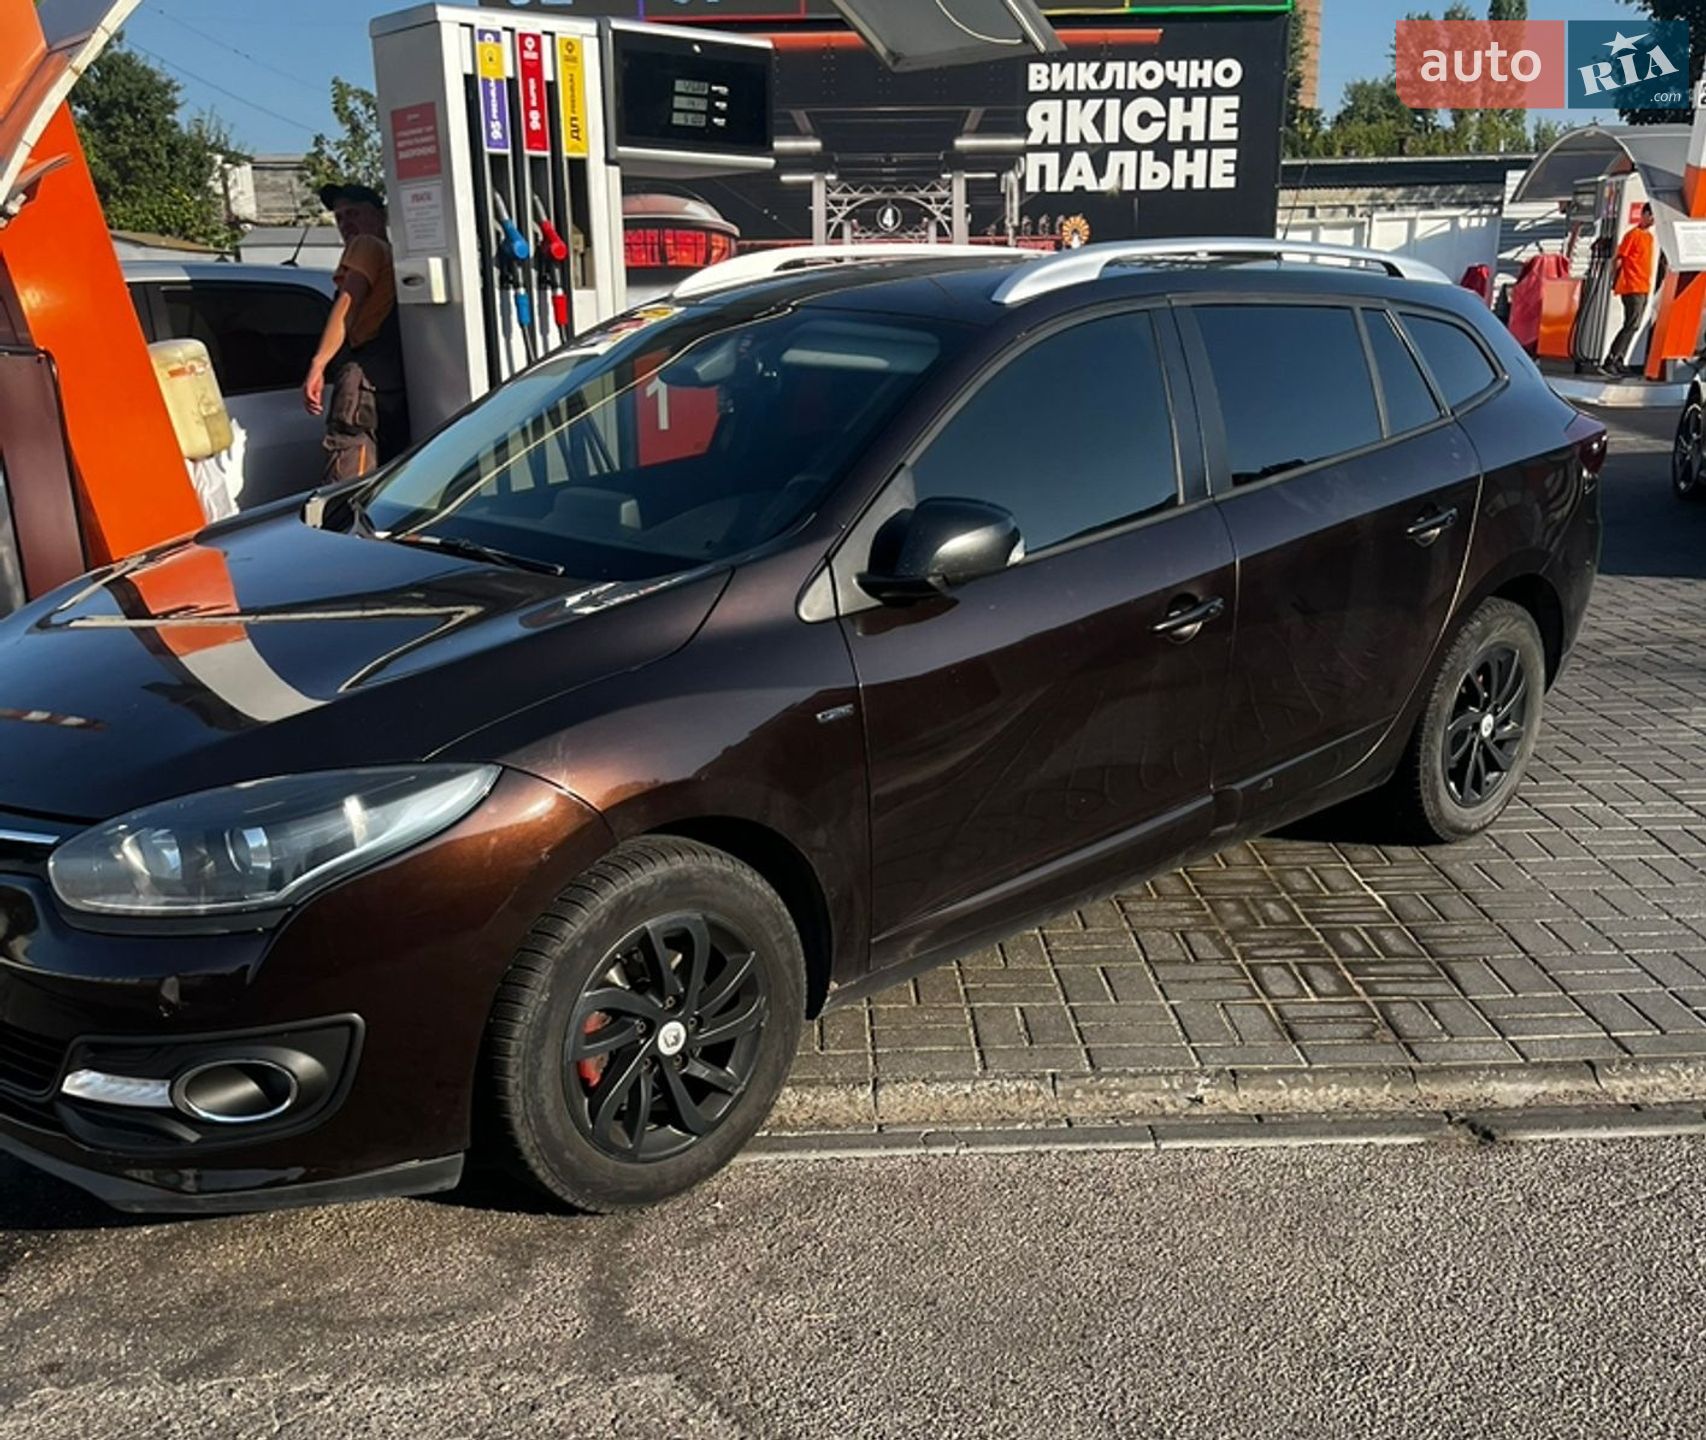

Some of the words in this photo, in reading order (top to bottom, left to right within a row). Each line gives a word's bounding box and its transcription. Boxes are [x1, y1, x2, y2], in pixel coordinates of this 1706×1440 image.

[1028, 58, 1243, 91] ВИКЛЮЧНО
[490, 120, 503, 140] 95
[1026, 96, 1240, 145] ЯКІСНЕ
[1025, 149, 1238, 192] ПАЛЬНЕ
[646, 376, 669, 430] 1
